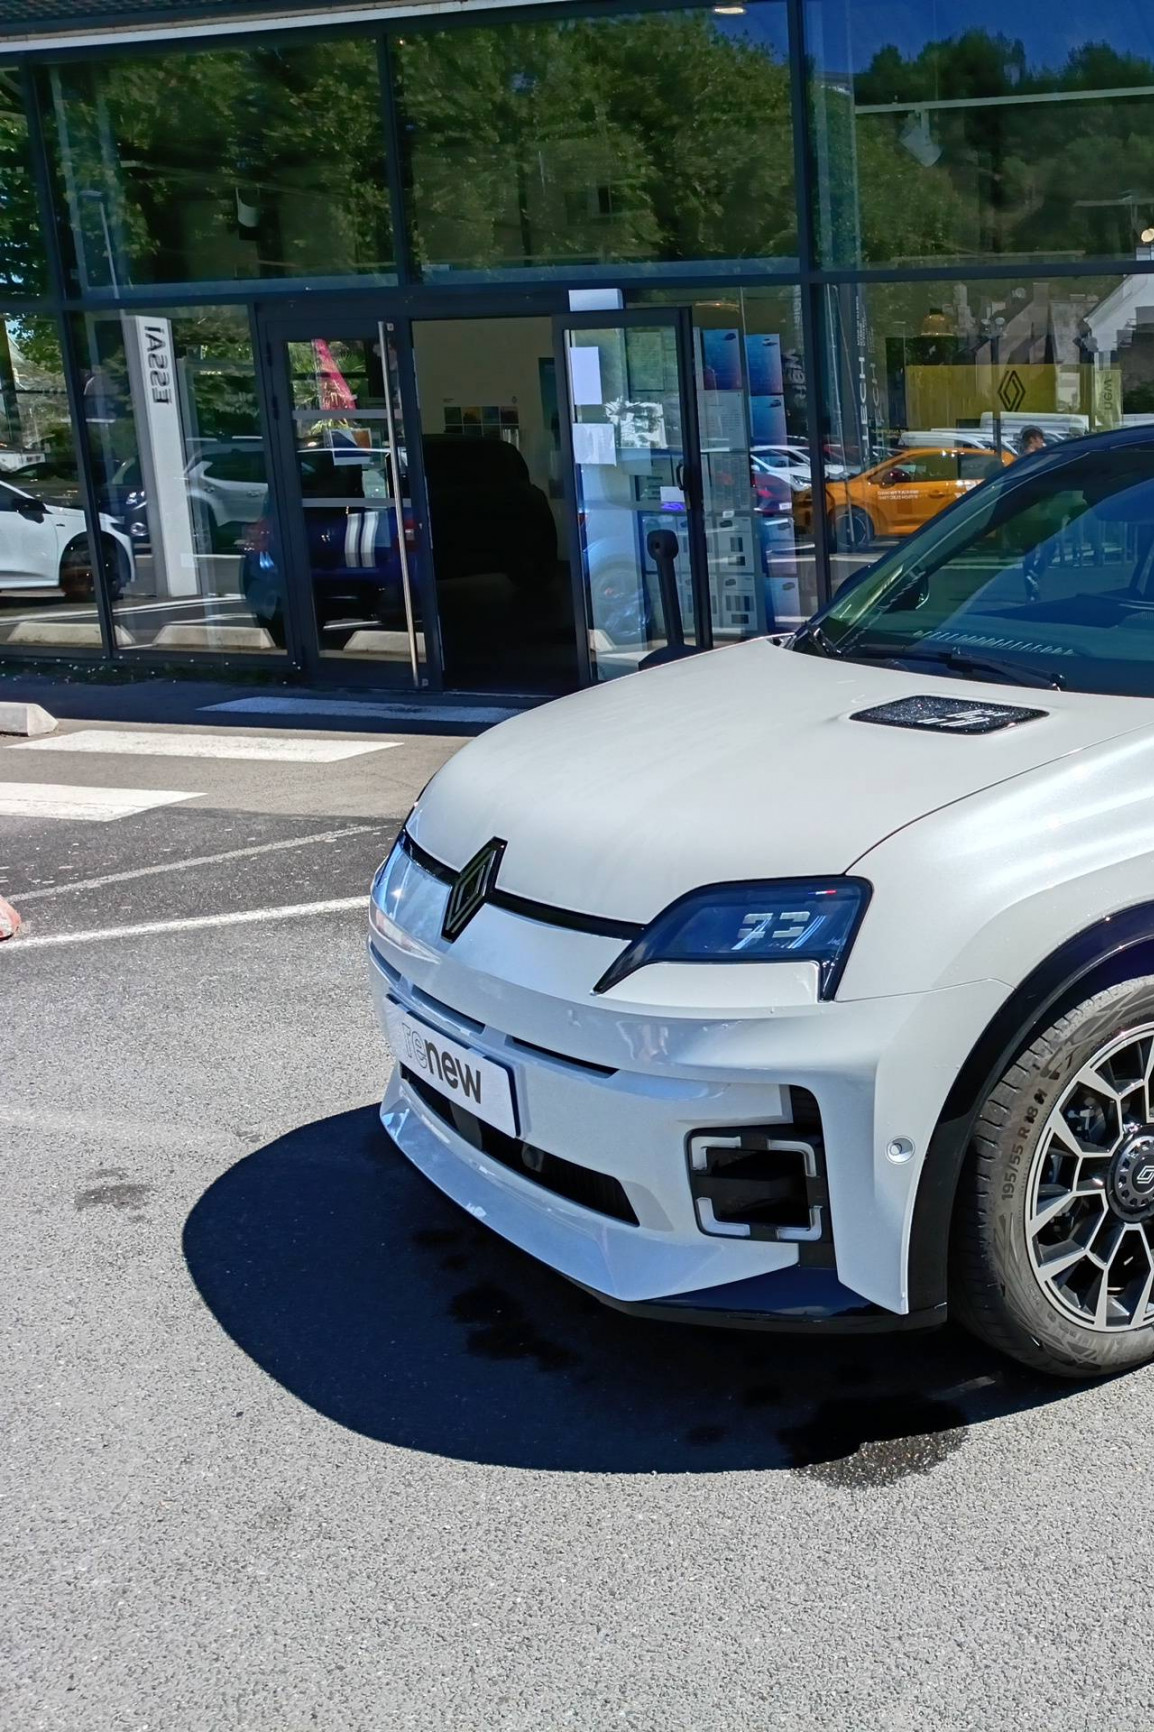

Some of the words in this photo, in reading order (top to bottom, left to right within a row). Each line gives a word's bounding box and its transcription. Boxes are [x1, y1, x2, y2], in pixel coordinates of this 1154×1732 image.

[402, 1022, 481, 1104] renew
[1017, 1127, 1031, 1139] R
[1023, 1106, 1039, 1124] 18
[1001, 1143, 1024, 1200] 195/55
